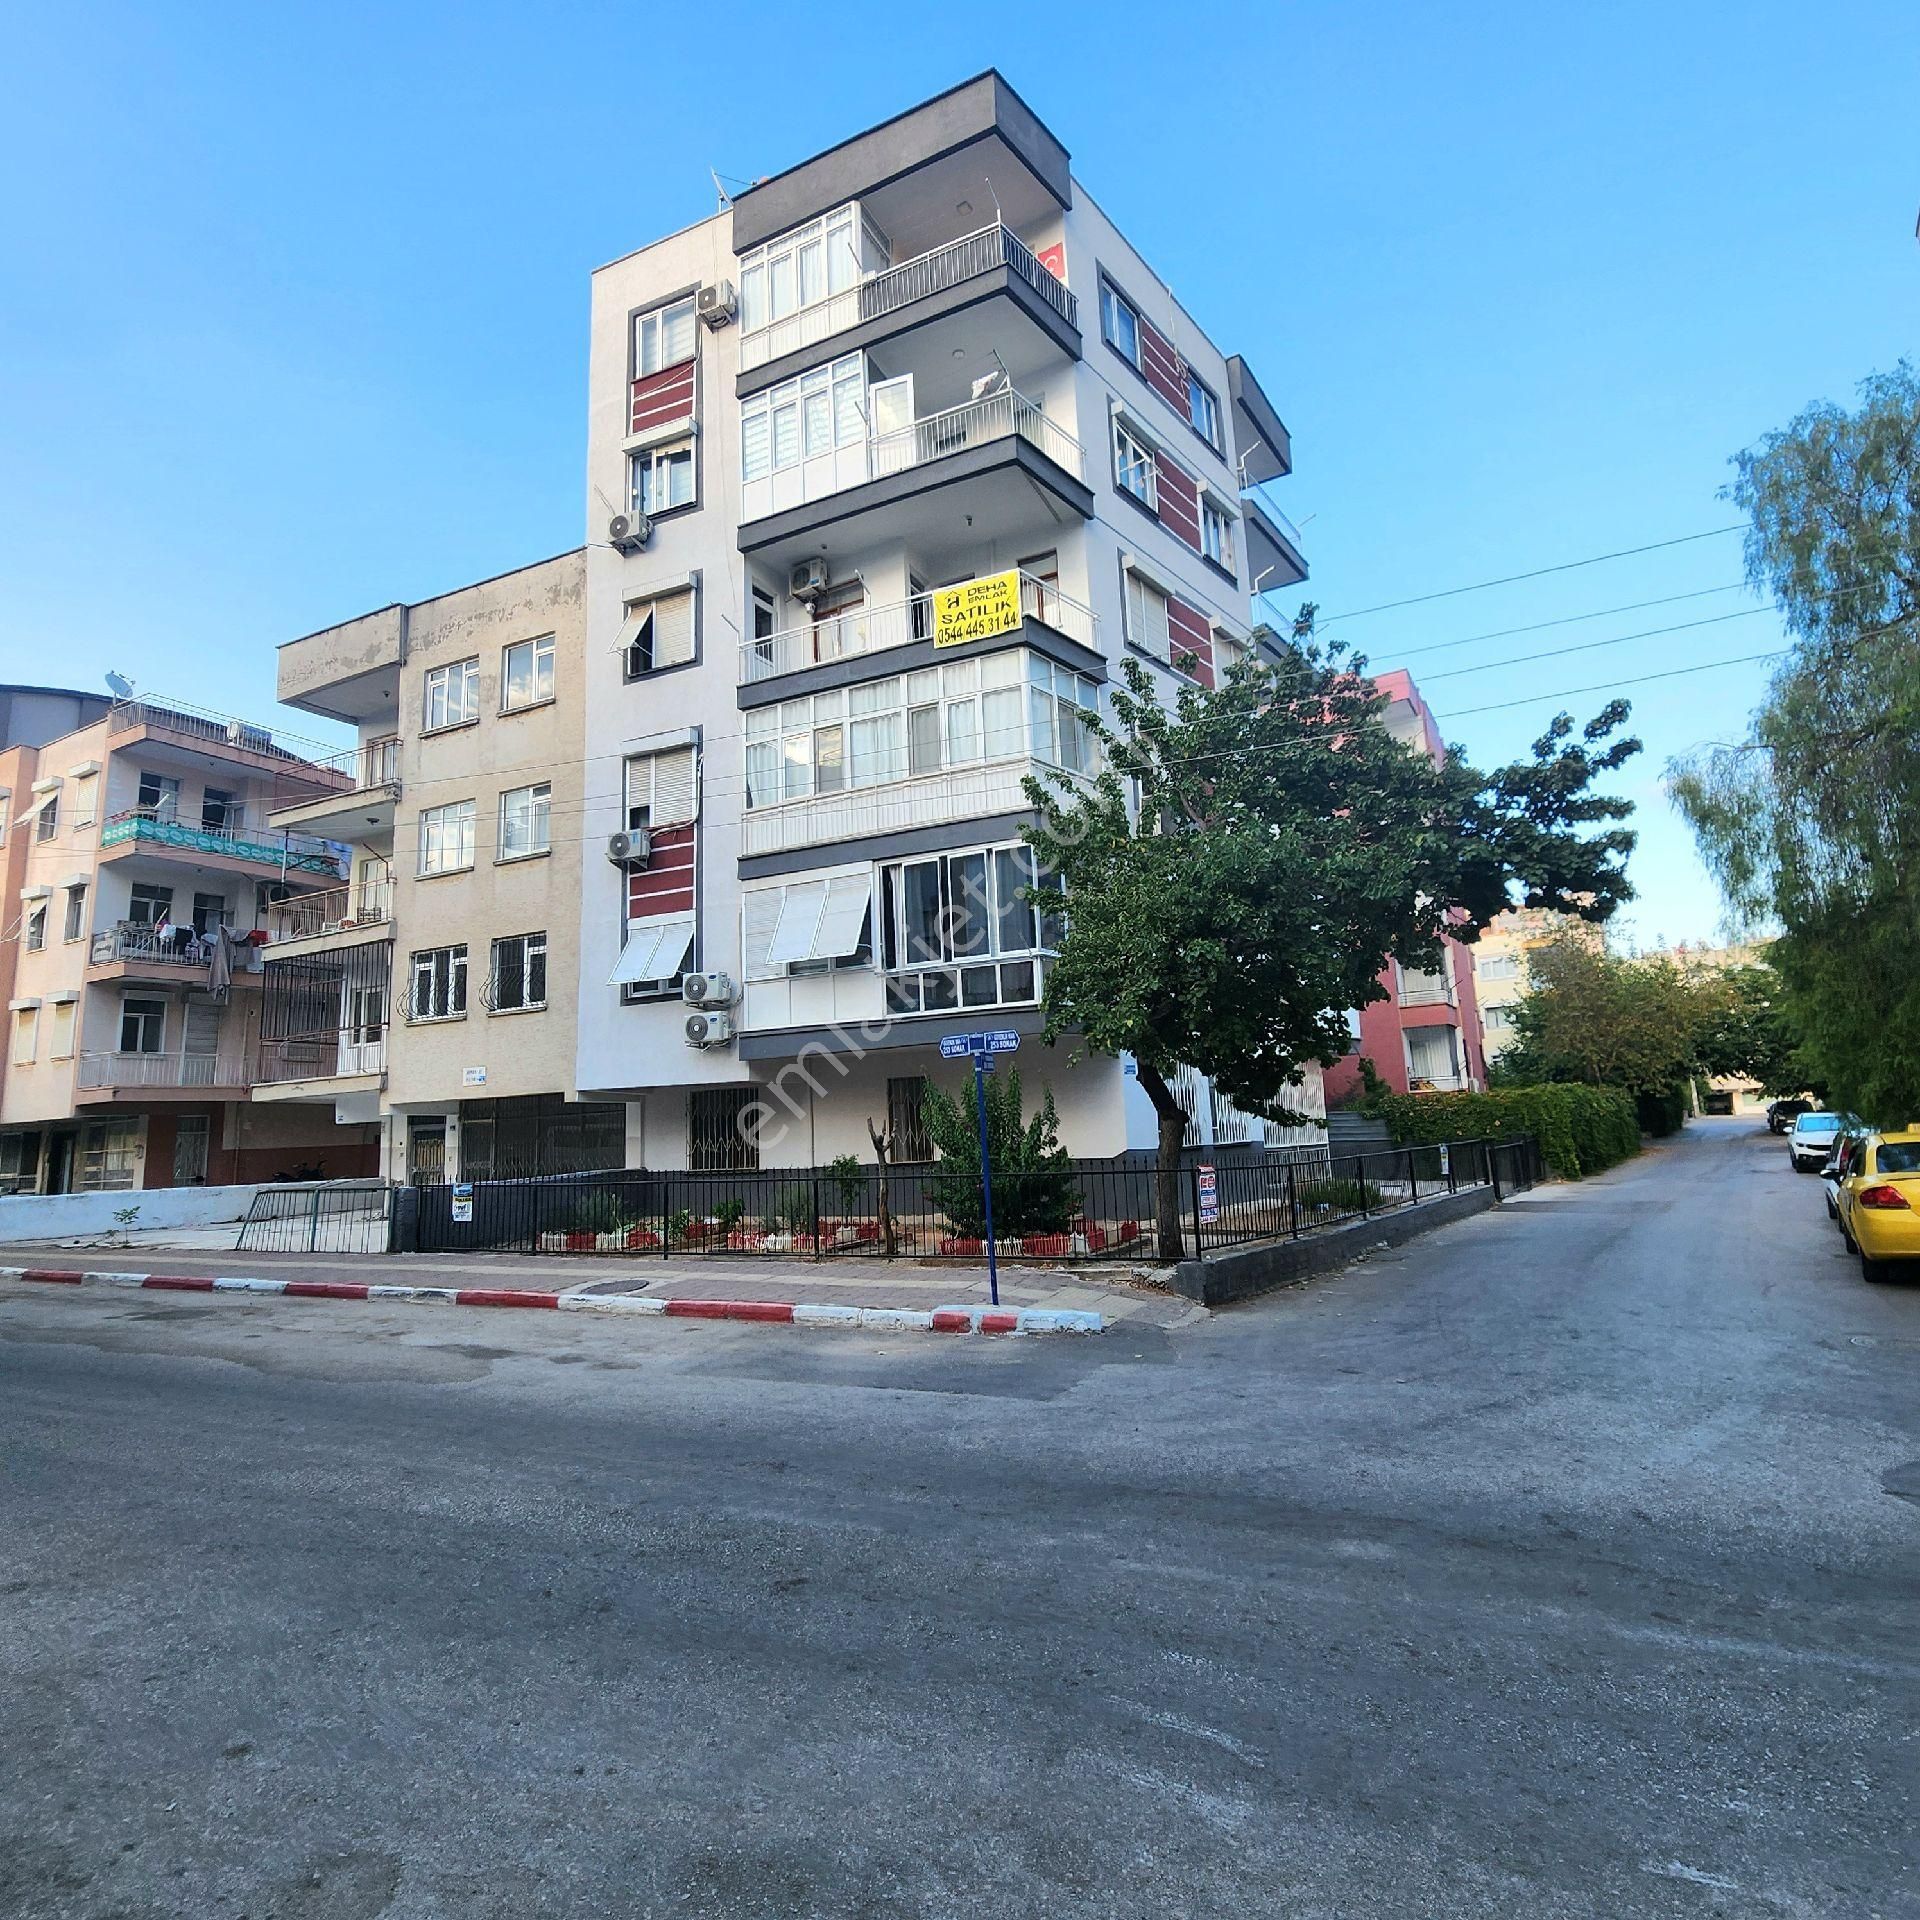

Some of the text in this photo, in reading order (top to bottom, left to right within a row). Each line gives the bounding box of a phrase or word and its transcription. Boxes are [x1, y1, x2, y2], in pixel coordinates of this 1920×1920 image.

[968, 581, 1007, 597] DEHA
[968, 589, 1008, 604] EMLAK
[941, 599, 1011, 625] SATILIK
[937, 611, 1017, 644] 0544 445 31 44
